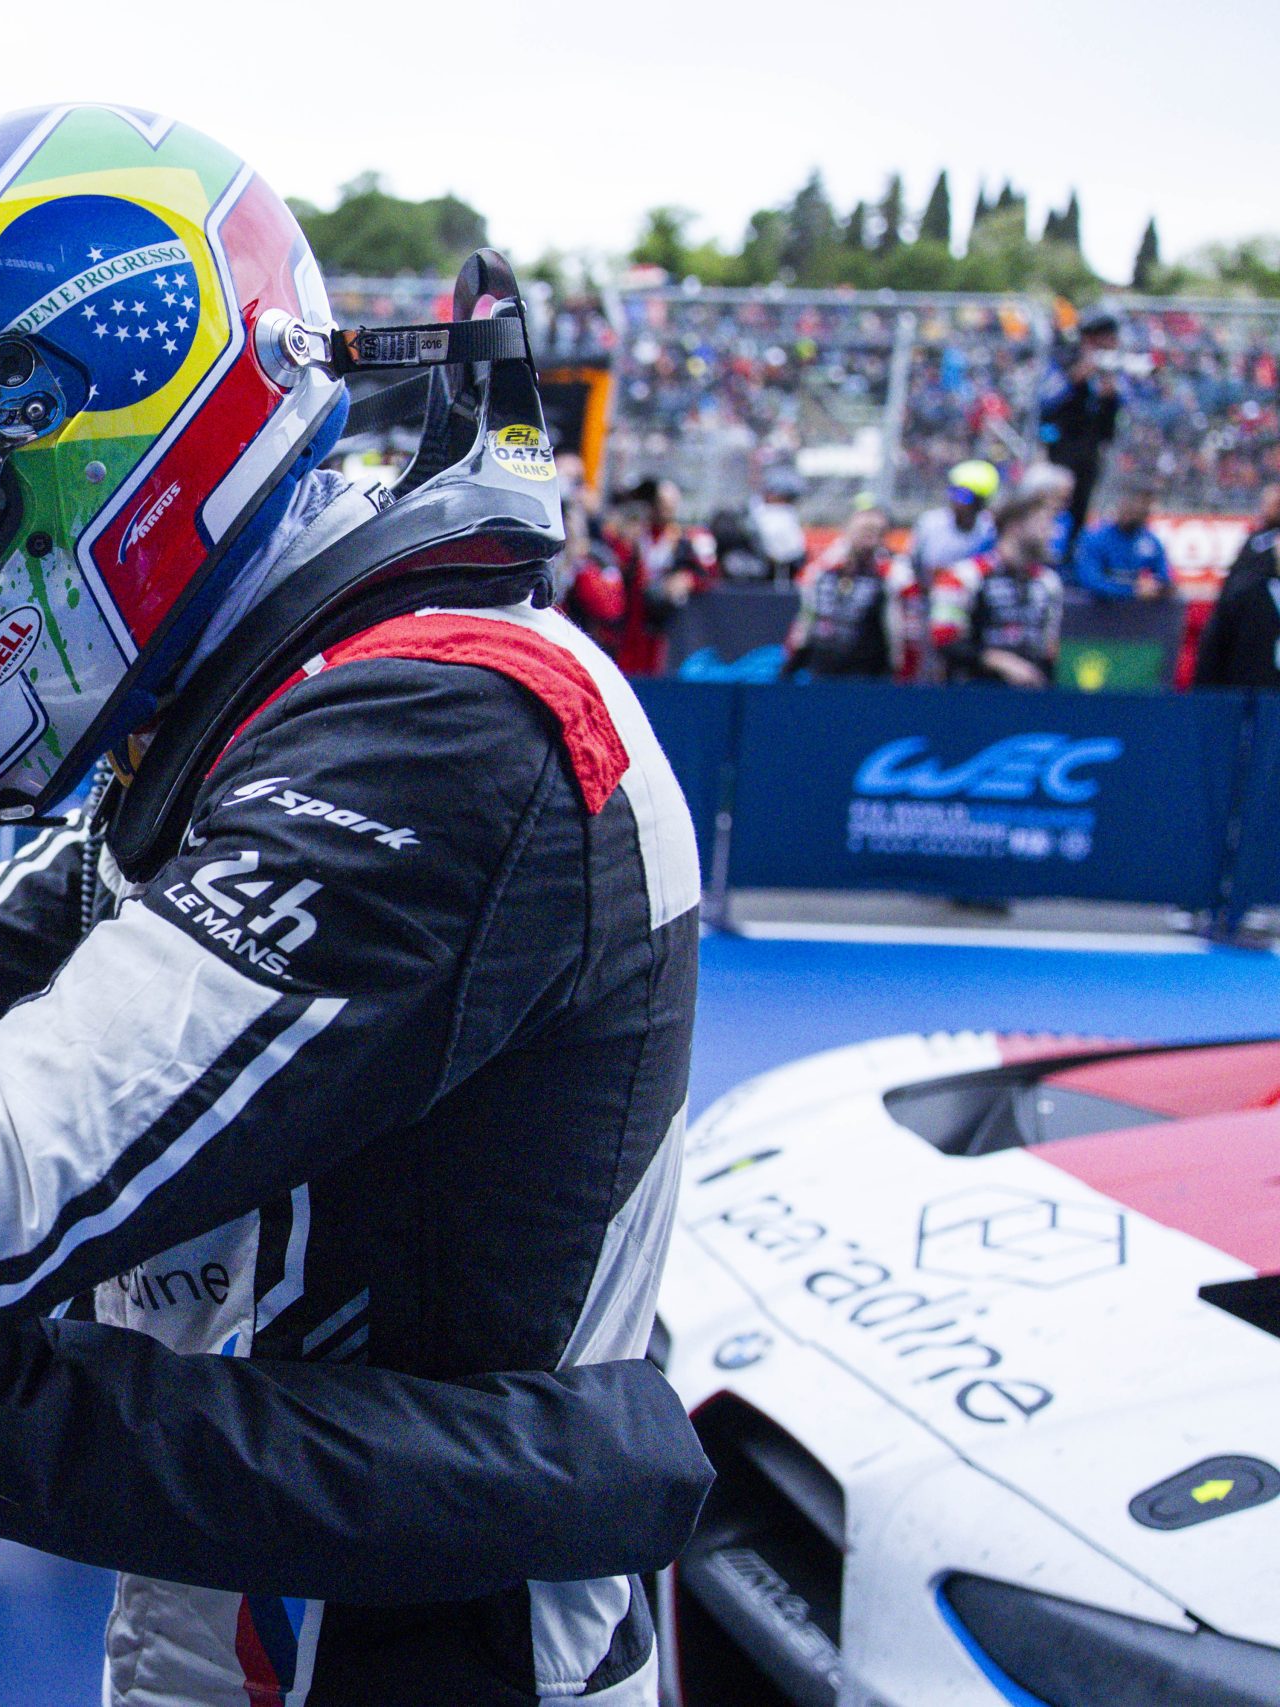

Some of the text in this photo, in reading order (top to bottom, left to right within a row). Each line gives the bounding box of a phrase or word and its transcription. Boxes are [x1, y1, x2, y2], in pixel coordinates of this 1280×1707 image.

[59, 285, 77, 305] E
[73, 246, 187, 296] PROGRESSO
[420, 339, 443, 350] 2016
[511, 463, 550, 477] HANS
[852, 732, 1124, 803] WEC
[267, 789, 421, 850] spark
[163, 882, 205, 915] LE
